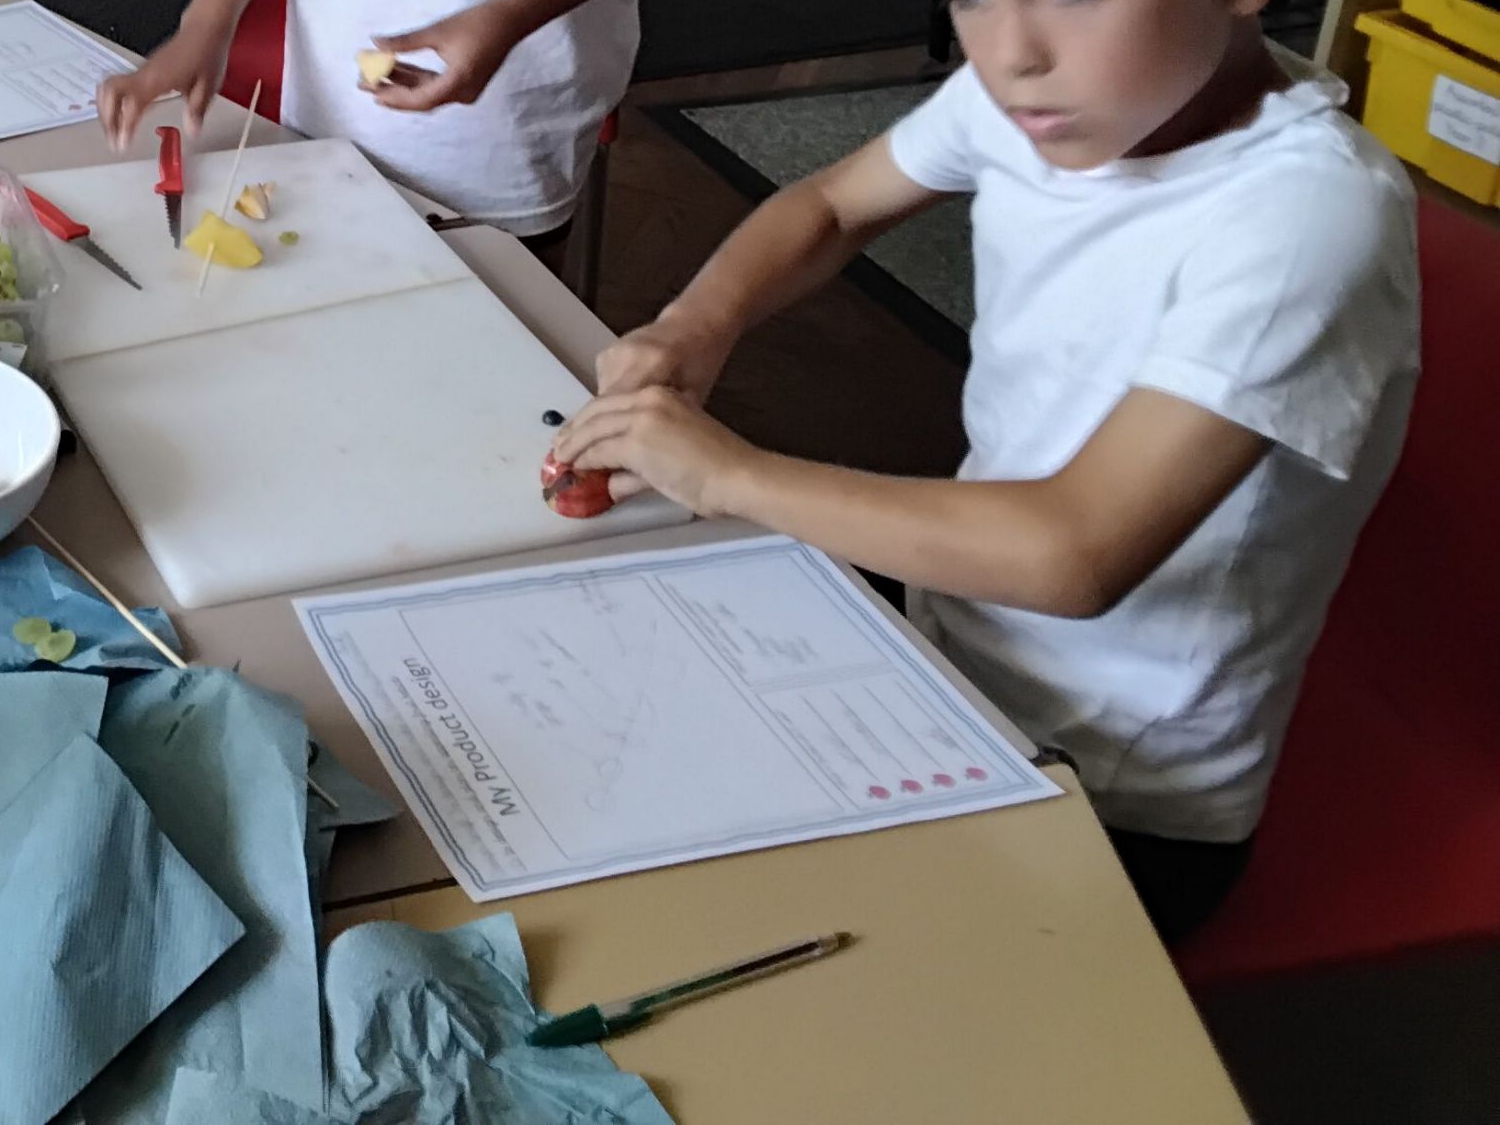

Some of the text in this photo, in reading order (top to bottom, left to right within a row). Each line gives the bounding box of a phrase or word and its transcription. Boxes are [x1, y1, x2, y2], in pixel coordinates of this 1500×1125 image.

[403, 657, 449, 710] design
[438, 712, 493, 782] Product
[488, 776, 520, 817] My
